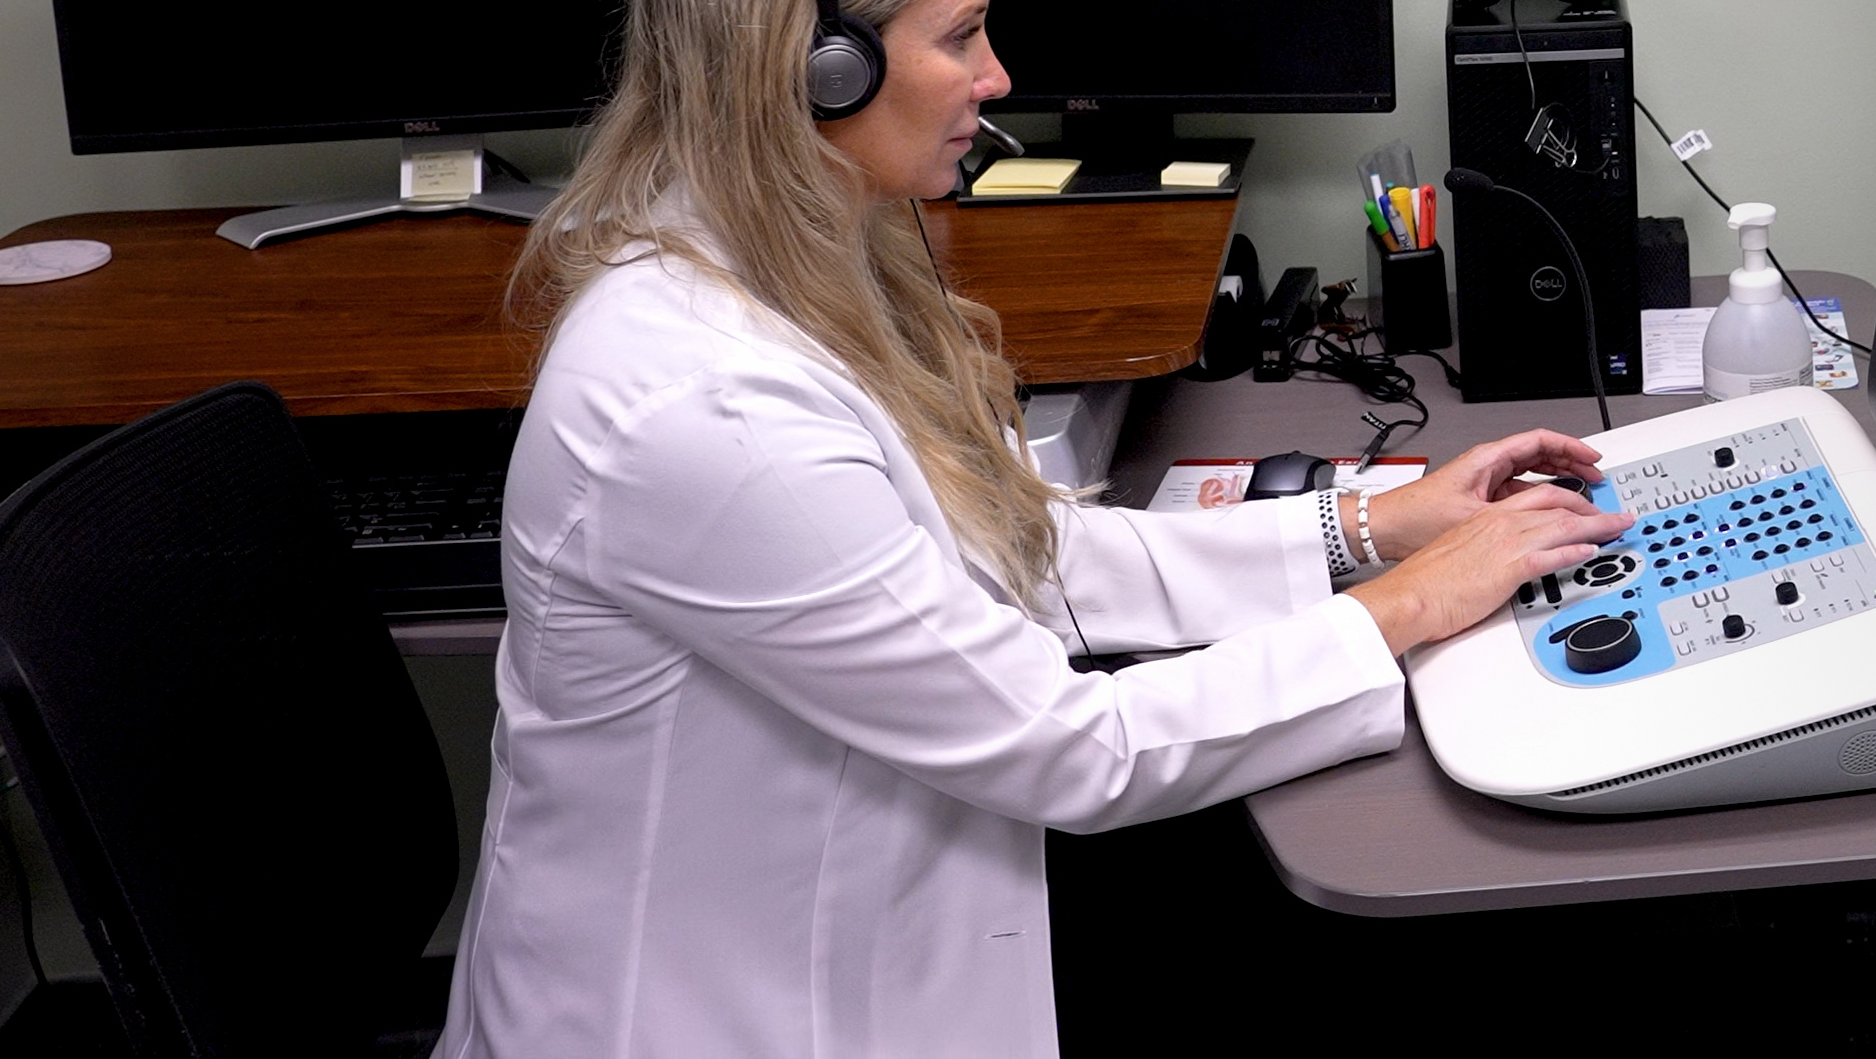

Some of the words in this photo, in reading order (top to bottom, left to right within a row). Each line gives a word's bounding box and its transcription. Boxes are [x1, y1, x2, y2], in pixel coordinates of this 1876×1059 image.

[1067, 99, 1100, 111] DELL
[404, 121, 441, 134] DELL
[1534, 278, 1563, 289] DELL
[1362, 411, 1388, 430] TITAN
